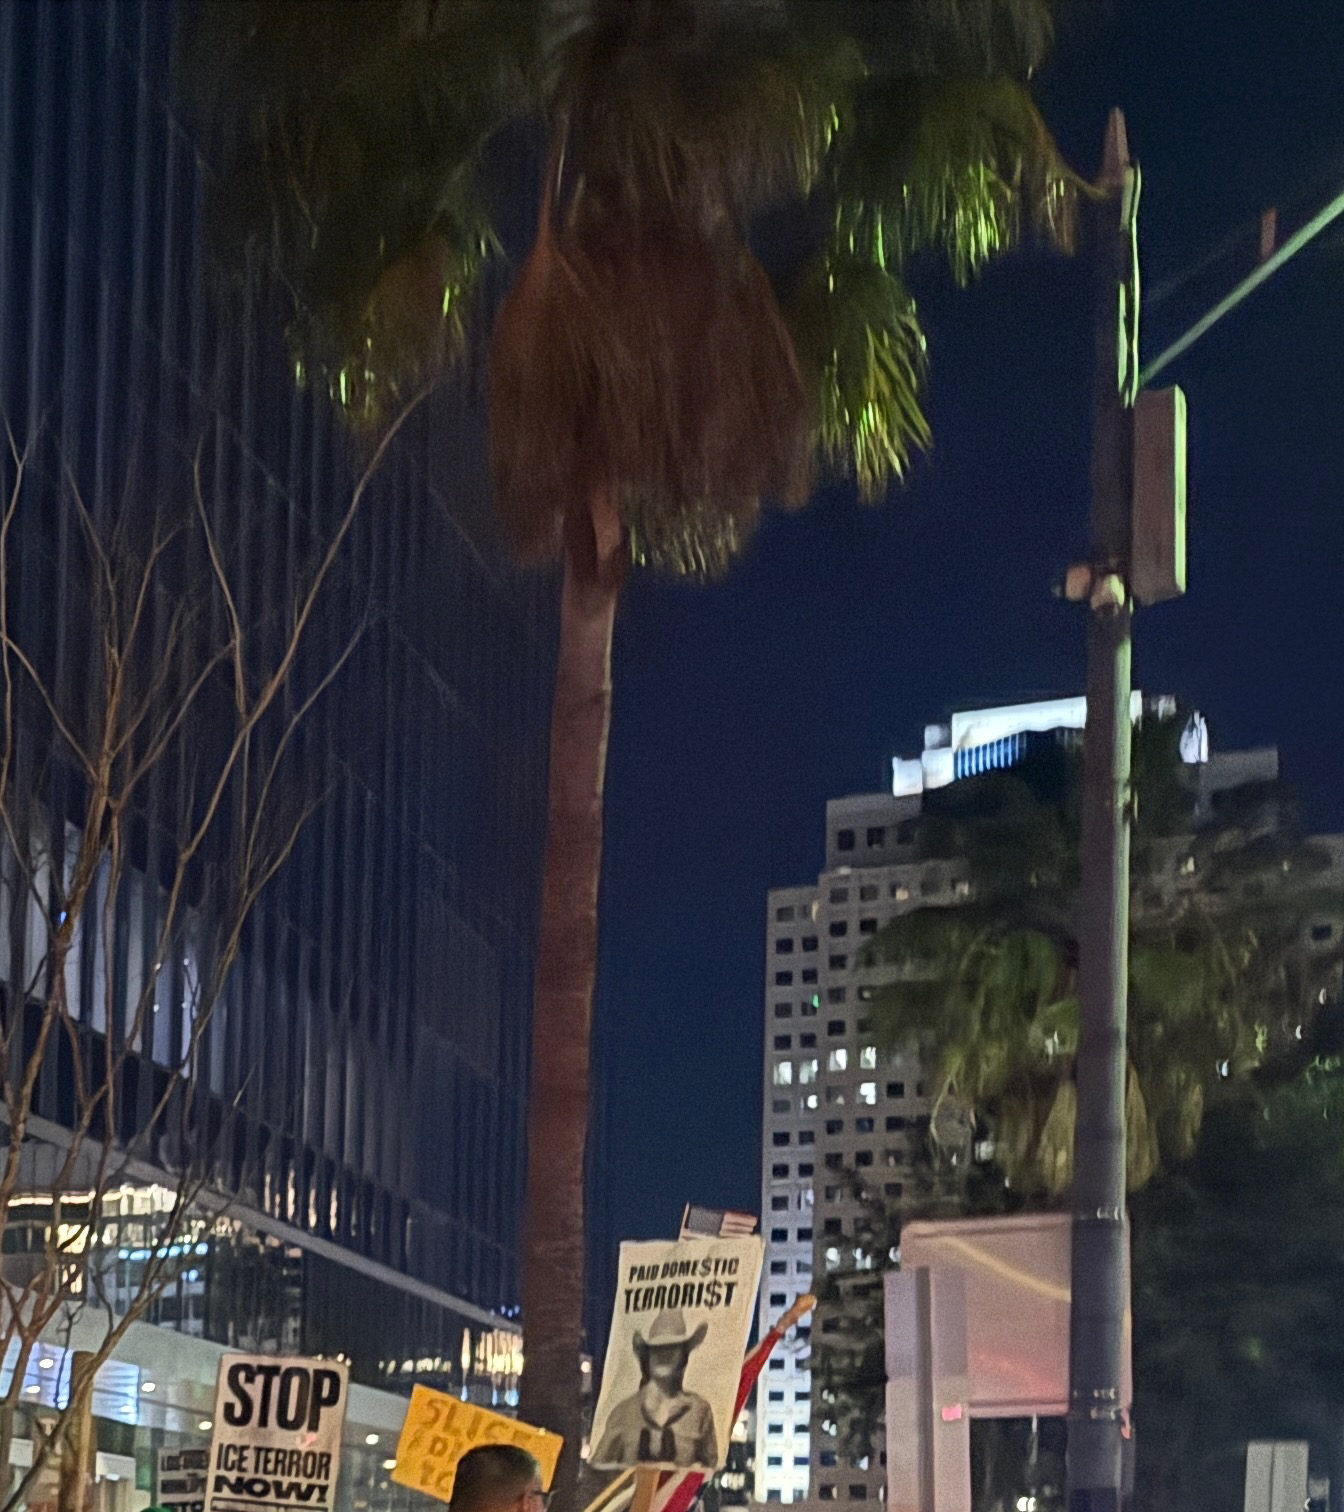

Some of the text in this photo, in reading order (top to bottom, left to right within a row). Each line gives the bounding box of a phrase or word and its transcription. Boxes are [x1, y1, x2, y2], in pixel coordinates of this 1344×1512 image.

[628, 1263, 660, 1284] PAID
[223, 1362, 341, 1432] STOP
[216, 1443, 250, 1474] ICE
[253, 1446, 332, 1481] TERROR
[213, 1475, 330, 1503] NOW!
